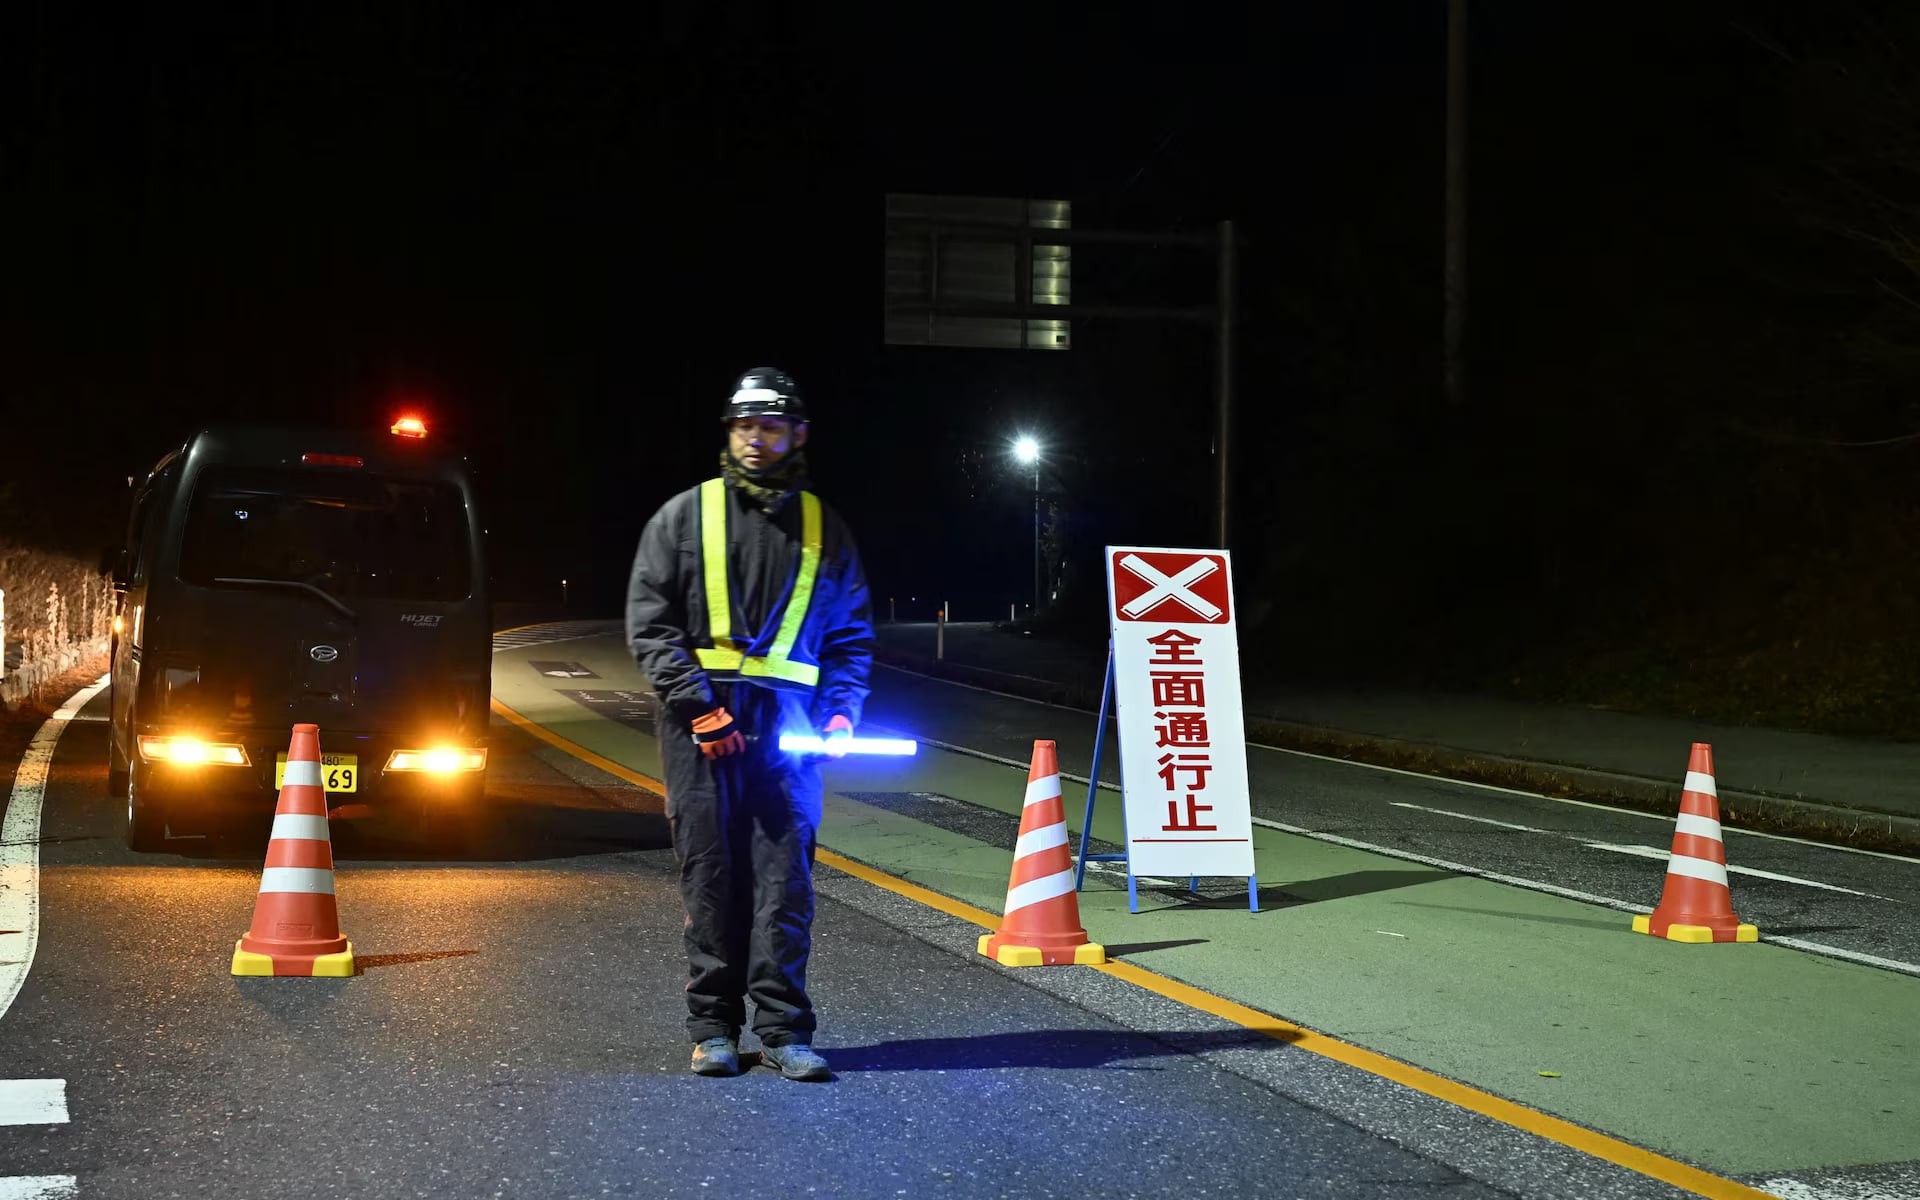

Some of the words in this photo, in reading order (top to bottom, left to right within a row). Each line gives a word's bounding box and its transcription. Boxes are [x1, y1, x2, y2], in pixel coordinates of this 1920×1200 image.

[400, 614, 445, 623] HIJET
[1147, 629, 1217, 831] 全面通行止
